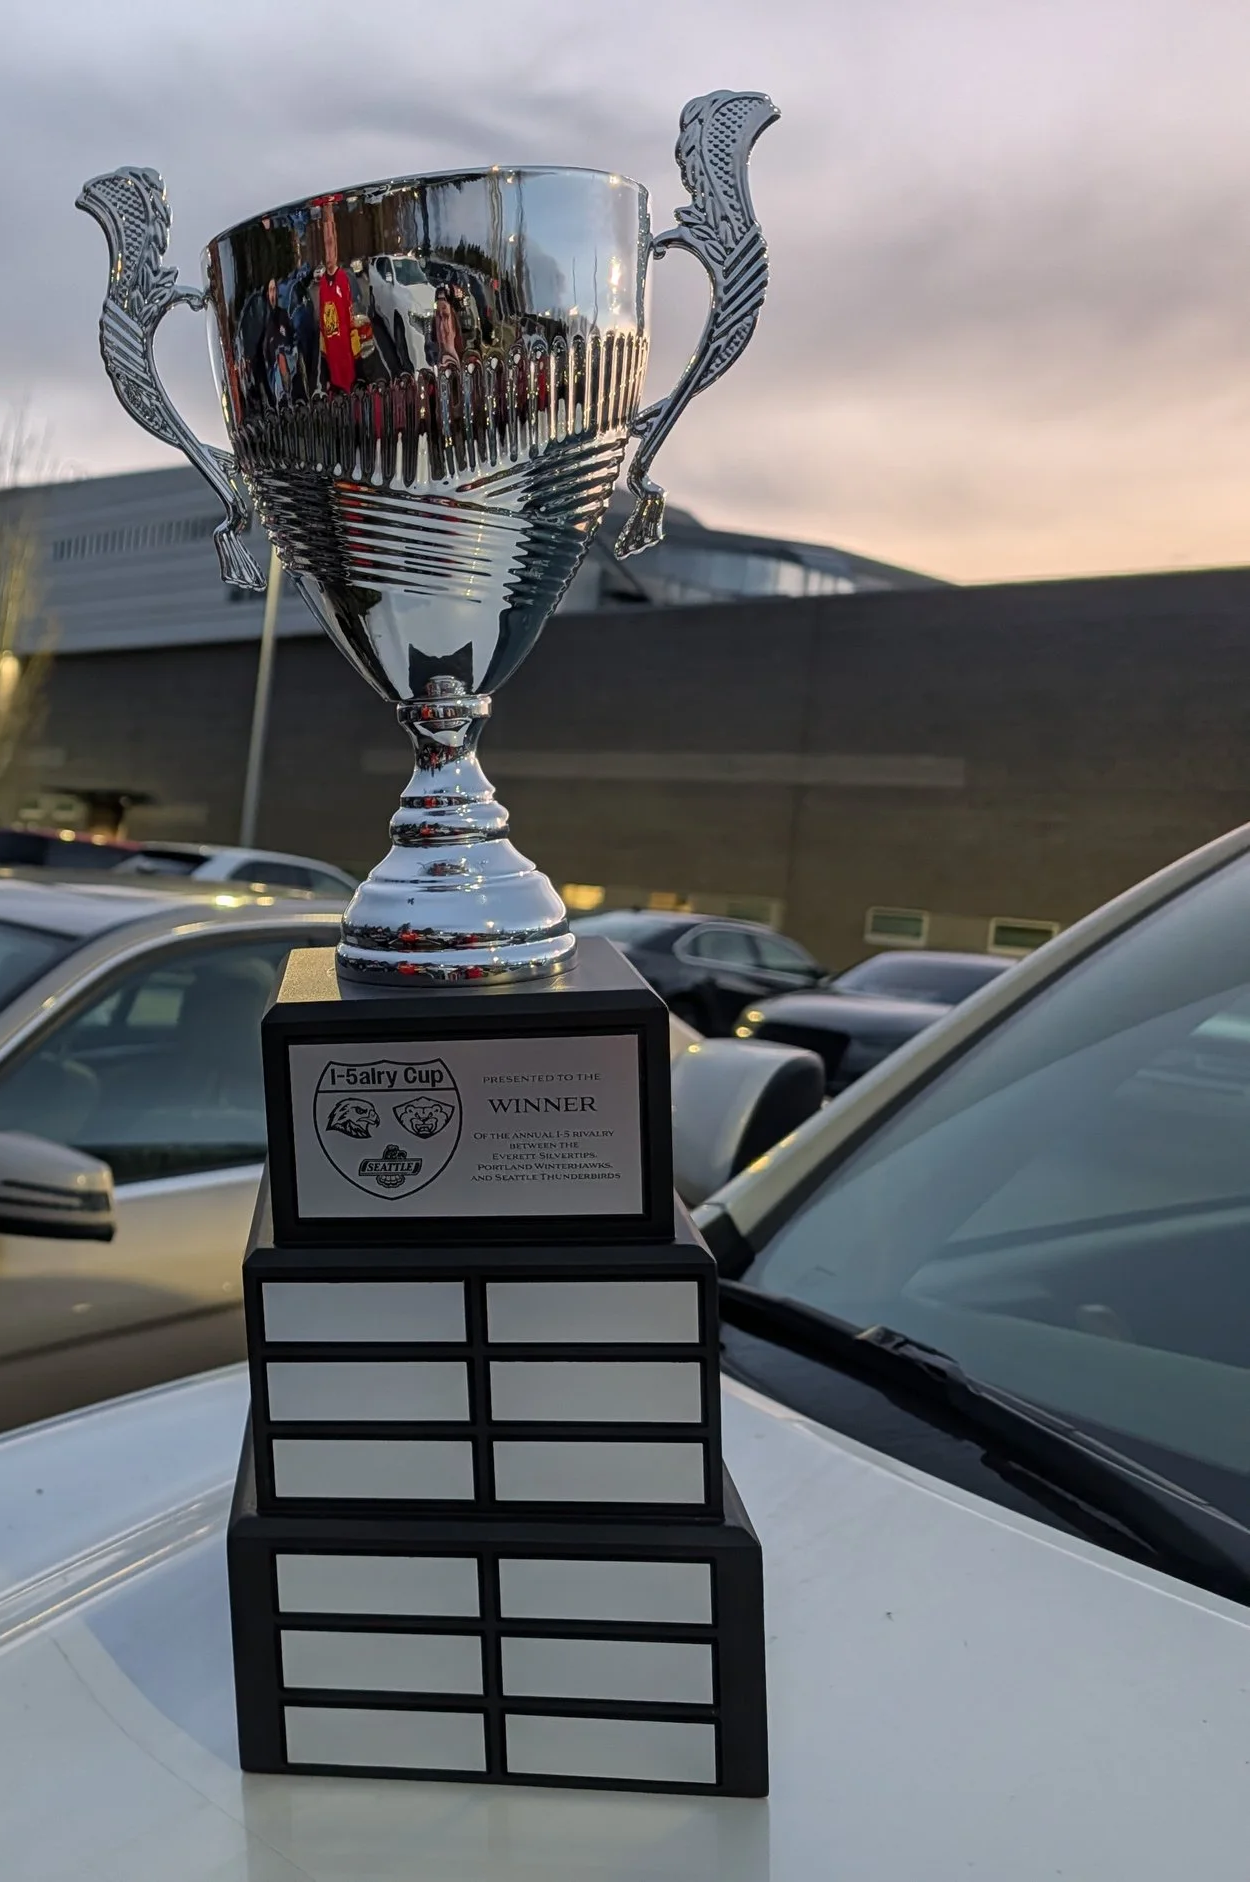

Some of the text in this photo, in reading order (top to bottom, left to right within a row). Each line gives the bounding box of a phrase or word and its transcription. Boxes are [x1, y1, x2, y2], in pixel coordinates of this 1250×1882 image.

[330, 1066, 444, 1088] I-5alry Cup
[482, 1074, 554, 1084] PRESENTED
[577, 1072, 602, 1081] THE
[487, 1096, 598, 1114] WINNER
[490, 1132, 510, 1140] THE
[512, 1131, 555, 1139] ANNUAL
[556, 1130, 570, 1138] I-5
[572, 1130, 615, 1138] RIVALRY
[509, 1141, 580, 1150] BETWEEN THE
[366, 1162, 414, 1172] SEATTLE
[471, 1174, 493, 1182] AND
